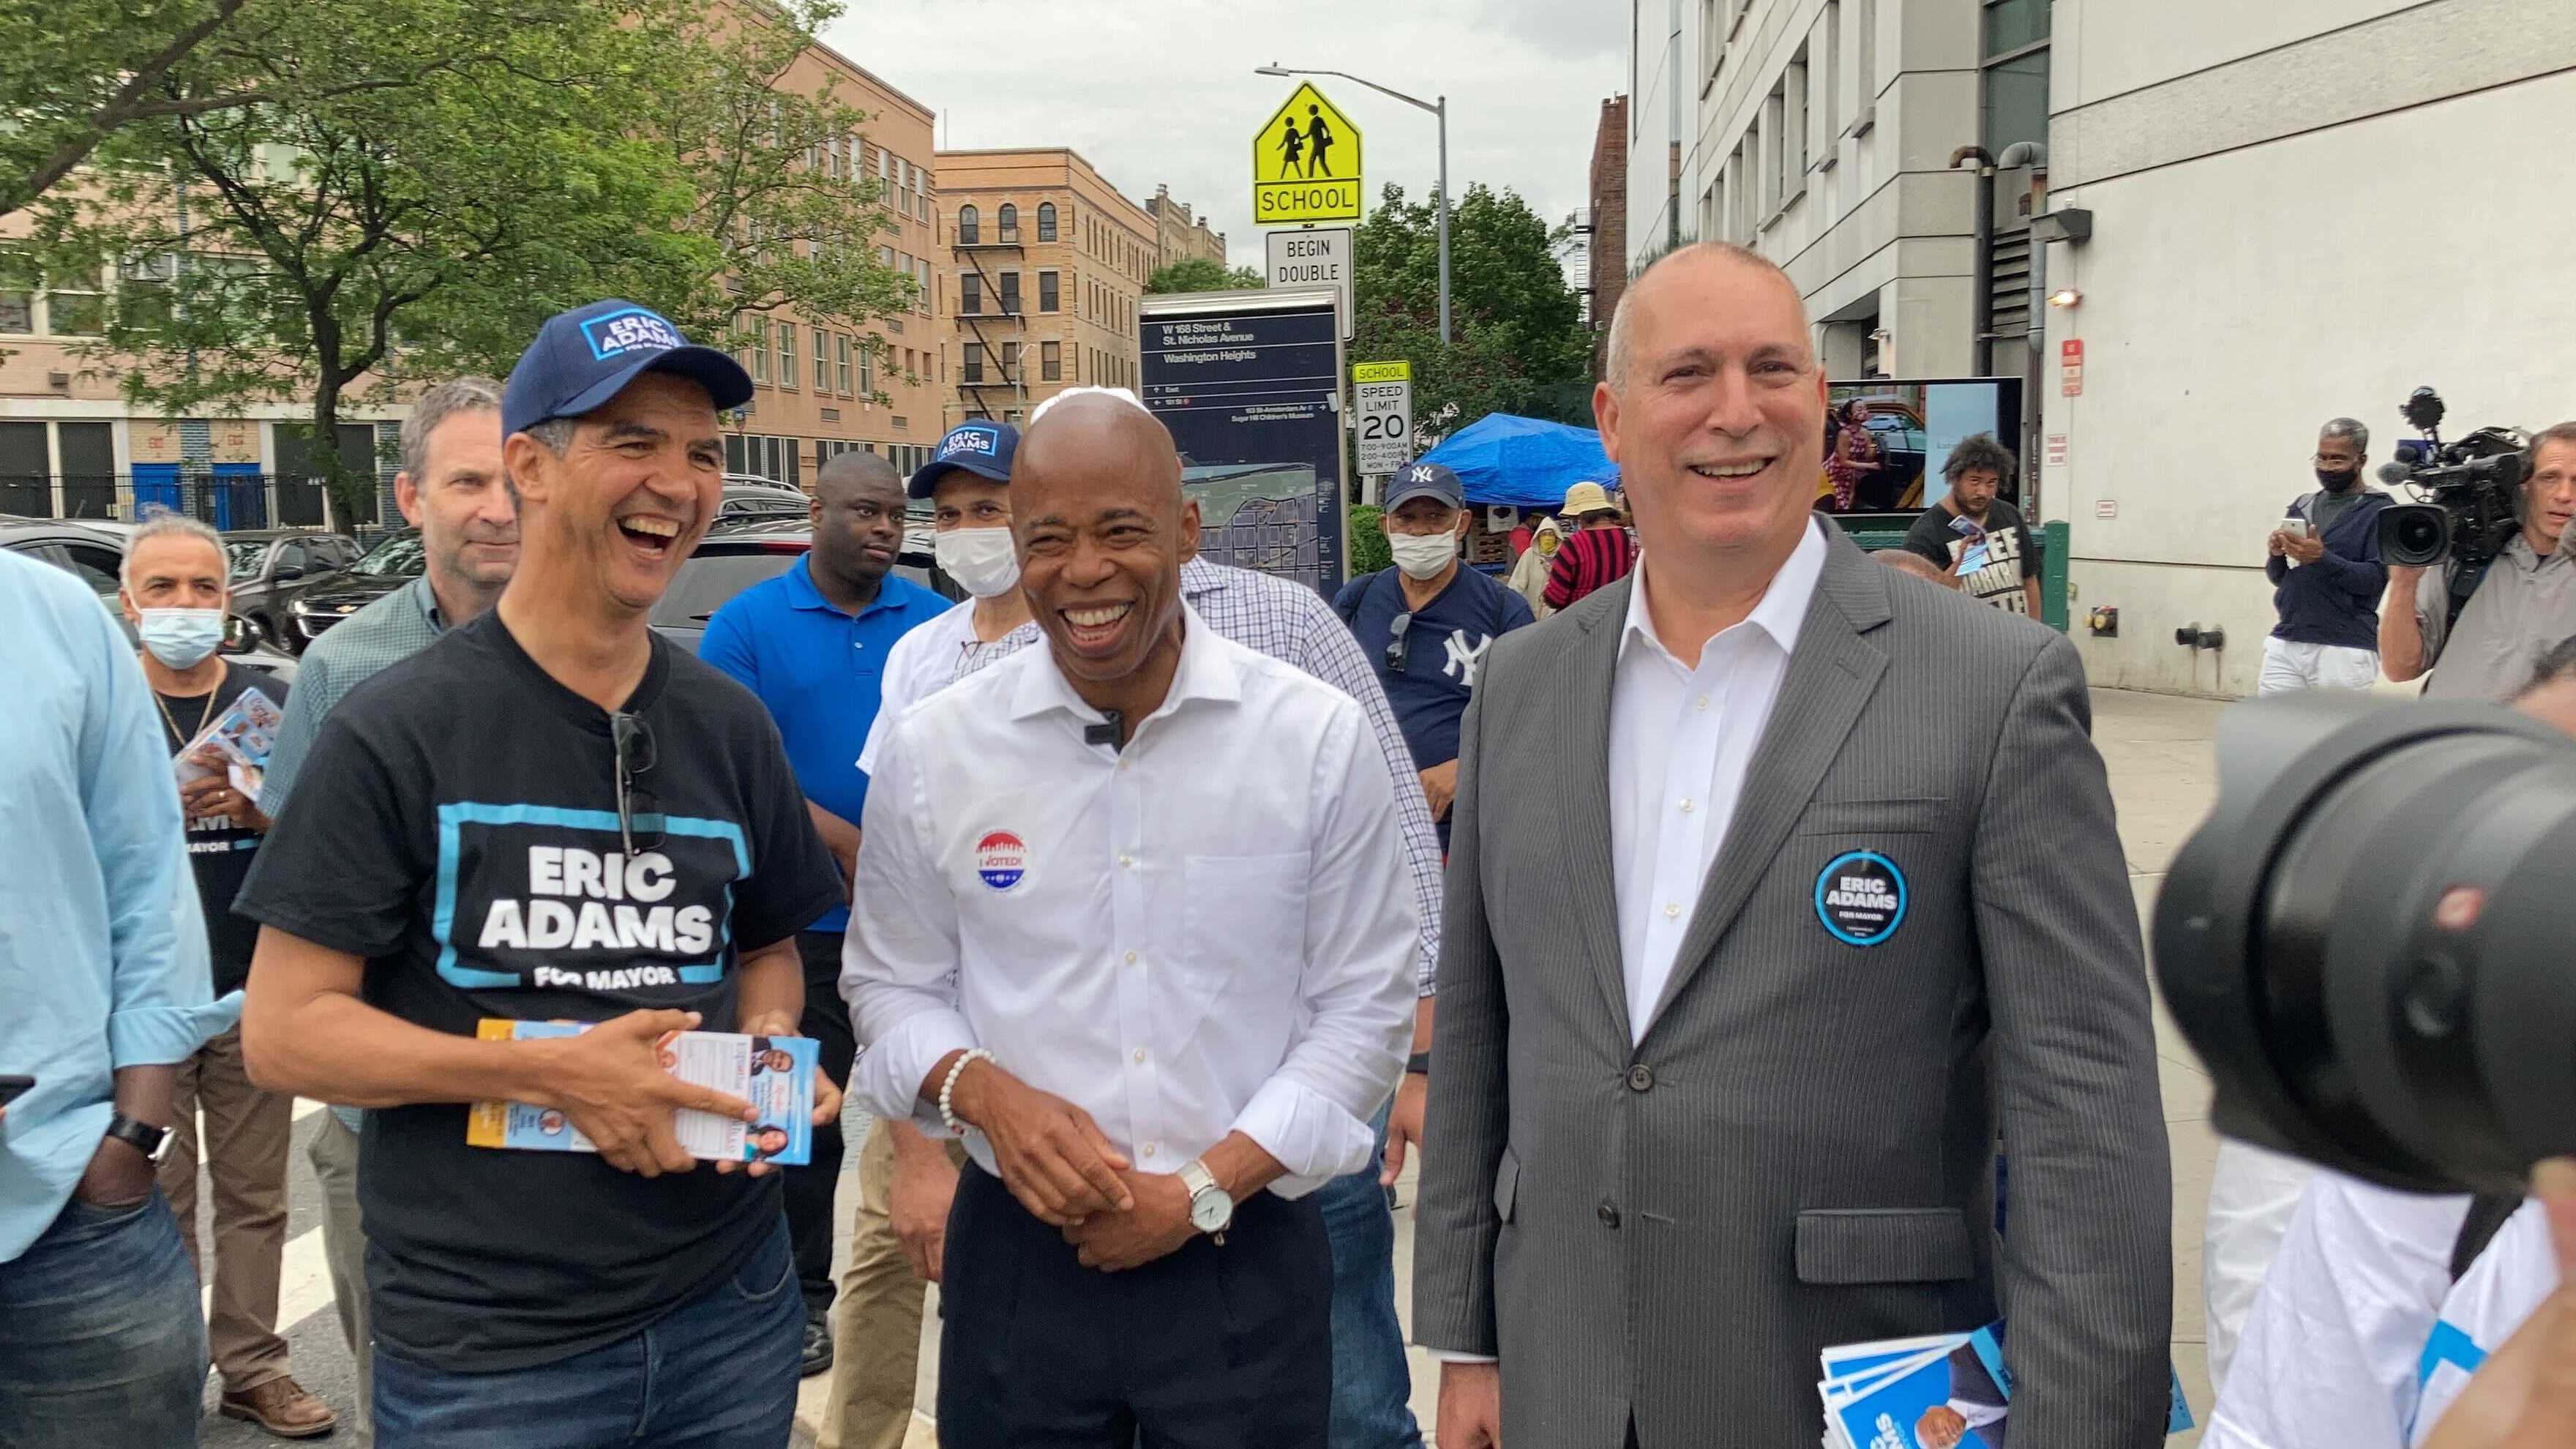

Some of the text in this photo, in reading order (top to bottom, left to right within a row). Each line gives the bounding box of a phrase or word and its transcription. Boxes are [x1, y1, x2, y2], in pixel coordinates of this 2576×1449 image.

[1261, 188, 1354, 211] SCHOOL
[1287, 240, 1330, 257] BEGIN
[1279, 264, 1338, 282] DOUBLE
[608, 316, 666, 336] ERIC
[1162, 322, 1231, 334] W 168 Street &
[1178, 334, 1218, 345] Nicholas
[1220, 333, 1254, 343] Avenue
[1164, 351, 1257, 364] Washington Heights
[1359, 367, 1404, 378] SCHOOL
[1361, 386, 1403, 397] SPEED
[1366, 400, 1399, 411] LIMIT
[1363, 414, 1404, 440] 20
[948, 431, 981, 444] ERIC
[940, 439, 990, 457] ADAMS
[1411, 465, 1433, 482] NY
[528, 845, 677, 902] ERIC
[1840, 876, 1887, 894] ERIC
[1825, 891, 1898, 910] ADAMS
[1838, 910, 1884, 921] FOR MAYOR
[478, 899, 714, 954] ADAMS
[585, 966, 677, 989] MAYOR
